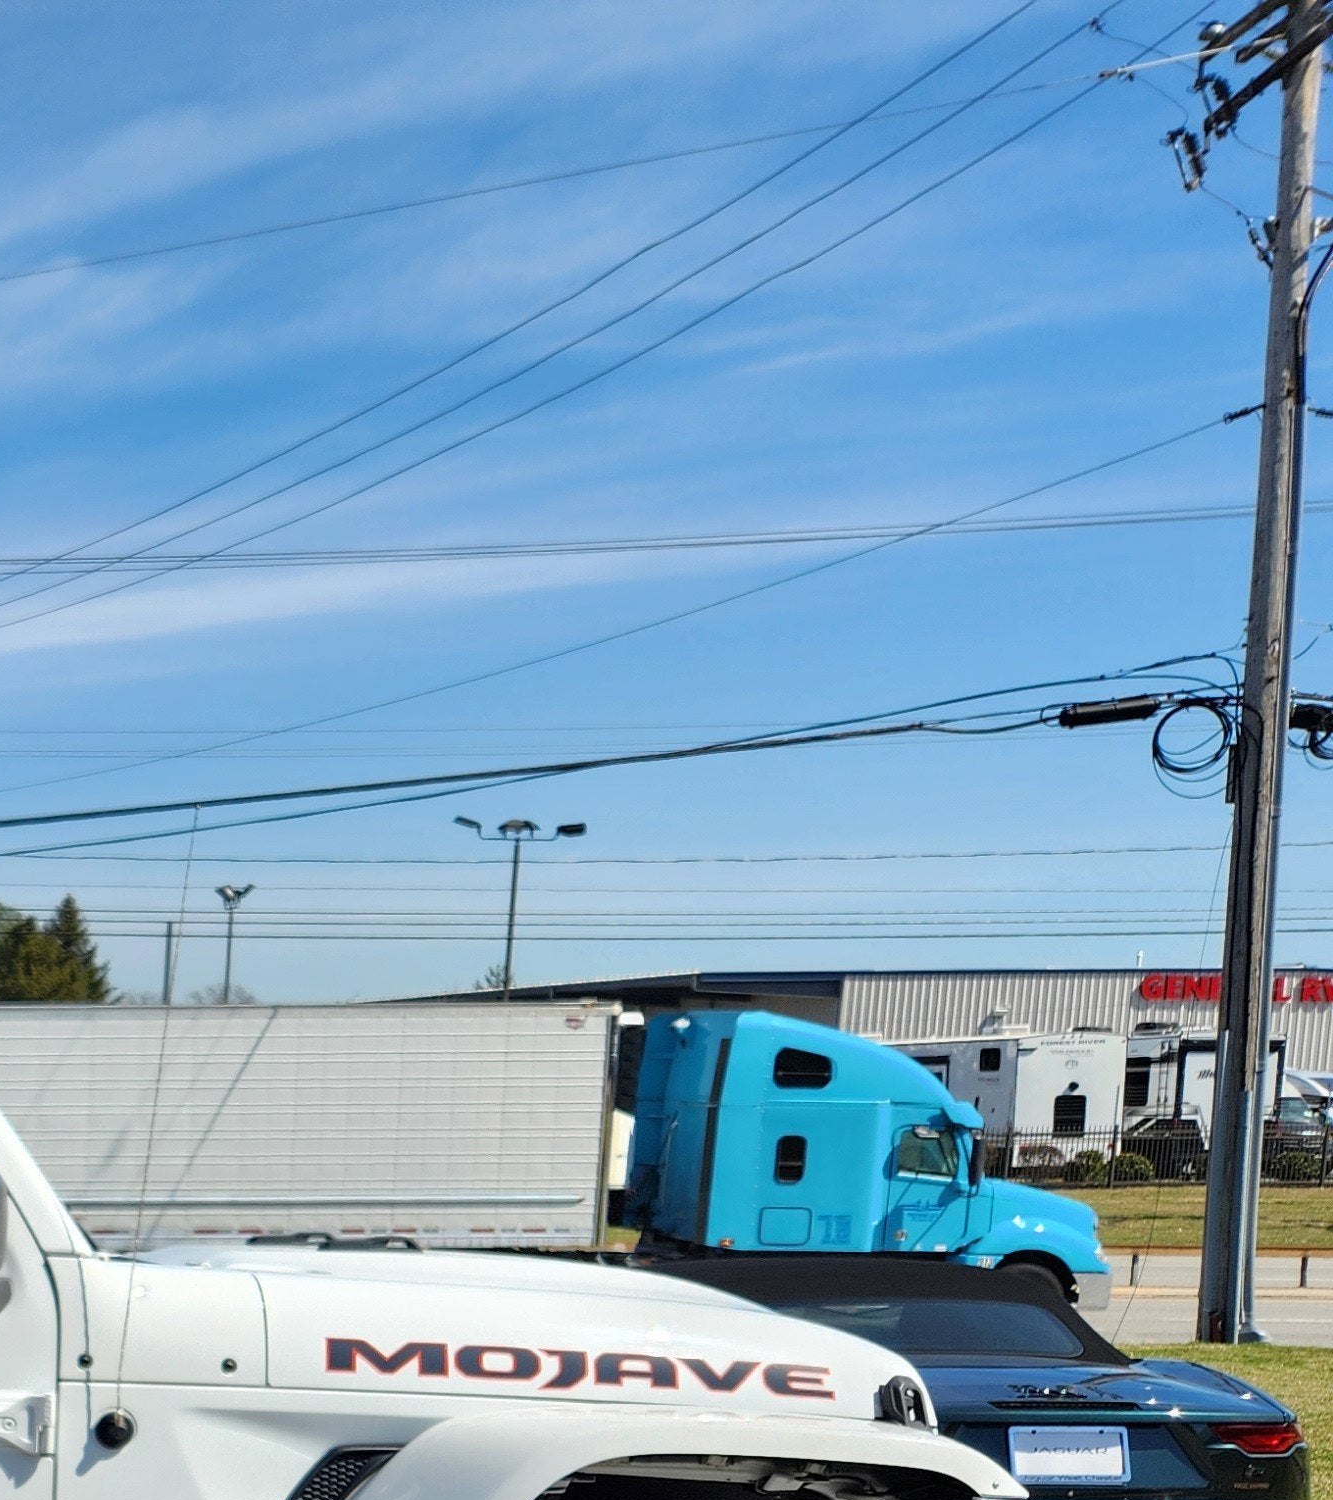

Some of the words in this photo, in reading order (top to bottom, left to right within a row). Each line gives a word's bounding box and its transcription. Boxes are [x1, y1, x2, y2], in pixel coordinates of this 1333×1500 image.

[1141, 973, 1291, 1003] GENEL
[325, 1337, 836, 1400] MOJAVE
[1028, 1446, 1109, 1456] JAGUAR
